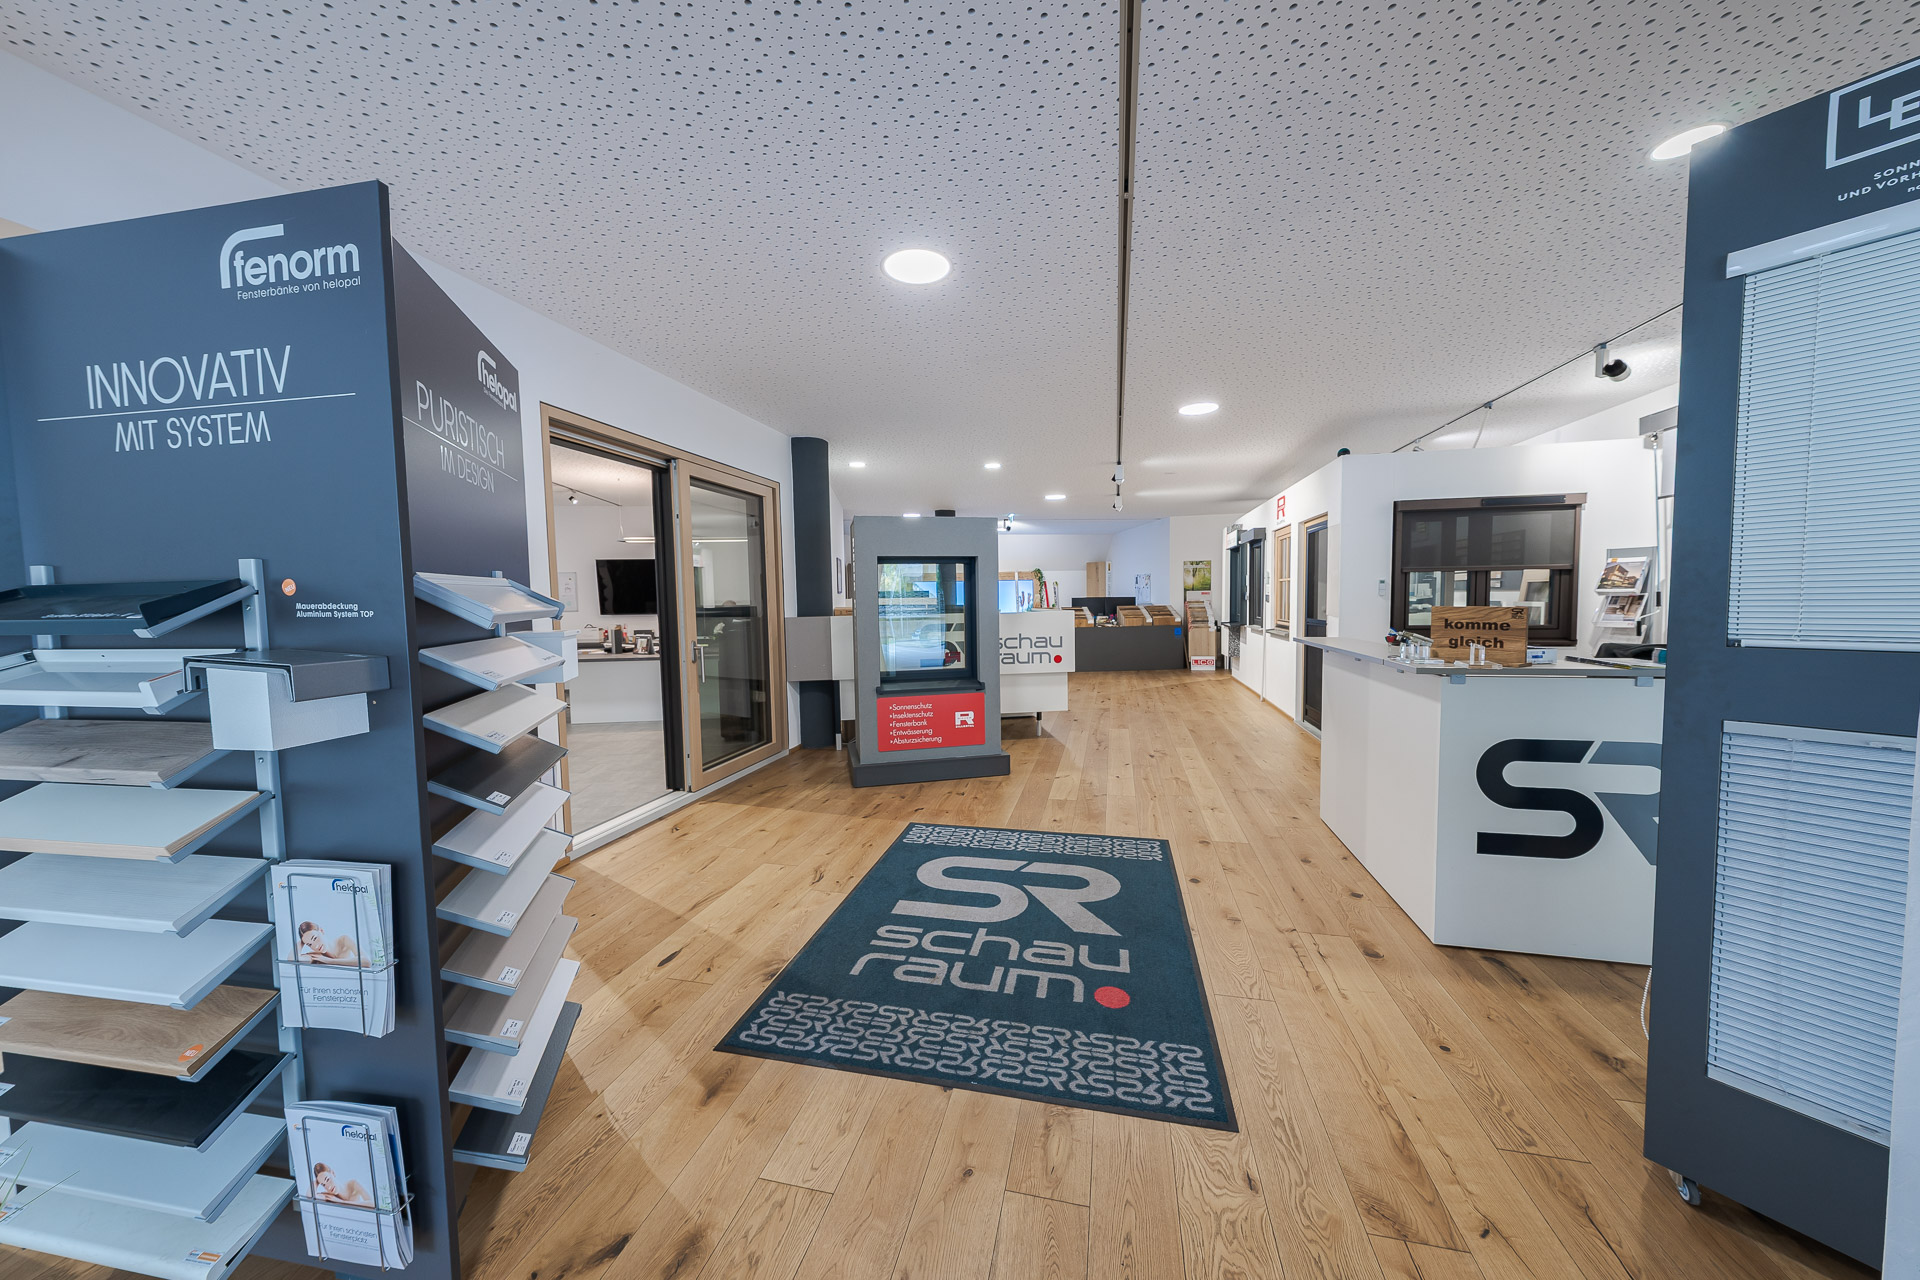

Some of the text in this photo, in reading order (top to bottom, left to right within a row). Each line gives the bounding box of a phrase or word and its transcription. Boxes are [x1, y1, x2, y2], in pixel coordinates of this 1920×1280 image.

[1837, 186, 1872, 202] UND
[233, 243, 360, 287] fenorm
[237, 275, 361, 300] Fensterbänke von helopal
[86, 345, 291, 410] INNOVATIV
[481, 361, 518, 413] helopal
[115, 410, 271, 452] MIT SYSTEM
[416, 380, 505, 469] PURISTISCH
[440, 445, 495, 493] IM DESIGN
[295, 602, 359, 611] Mauerabdeckung
[296, 610, 374, 619] Aluminium System TOP
[1444, 618, 1511, 631] komme
[1448, 635, 1504, 649] gleich
[892, 702, 932, 711] Sonnenschutz
[892, 711, 934, 719] Insektenschutz
[892, 719, 928, 728] Fensterbank
[892, 728, 933, 736] Entwässerung
[892, 736, 943, 744] Absturzsicherung
[891, 856, 1122, 937] SR
[869, 925, 1131, 974] schau
[312, 986, 331, 994] Ihren
[332, 987, 368, 996] schönstn
[313, 994, 357, 1003] Fensterplatz
